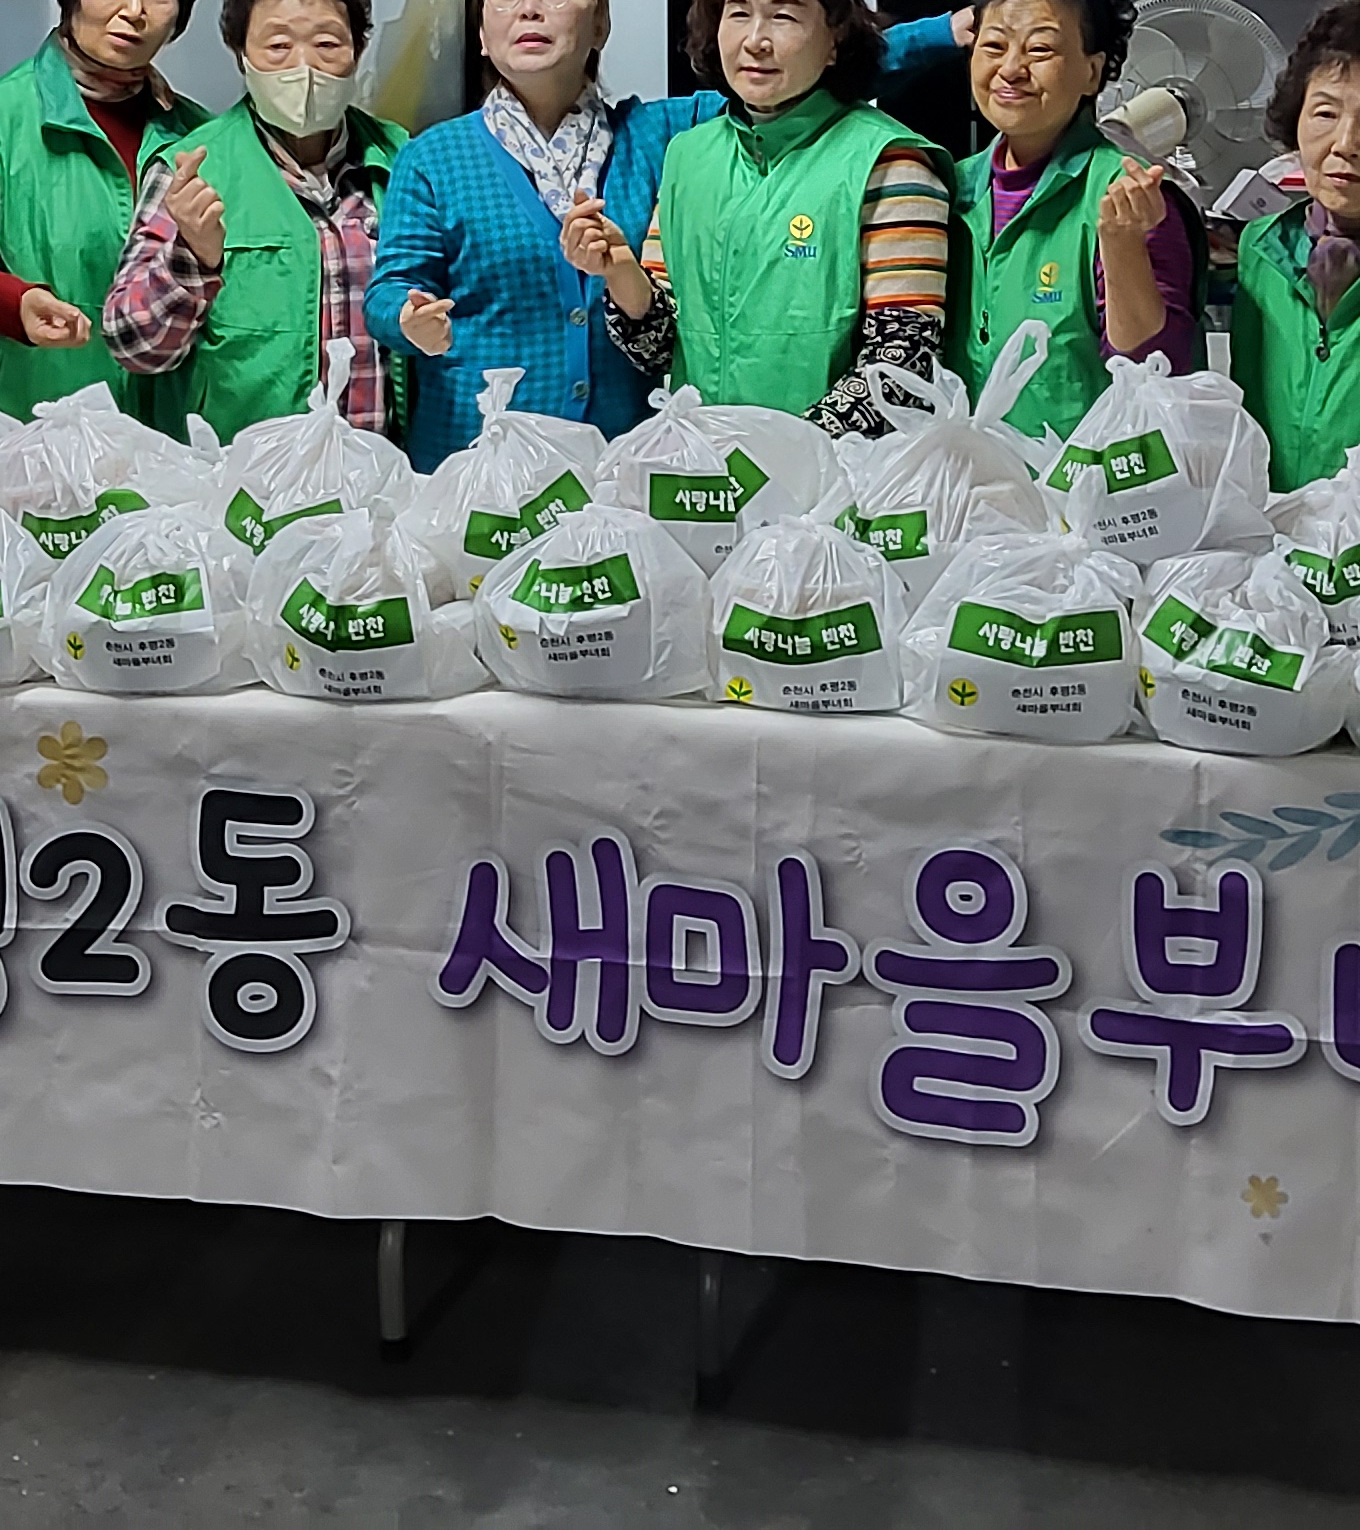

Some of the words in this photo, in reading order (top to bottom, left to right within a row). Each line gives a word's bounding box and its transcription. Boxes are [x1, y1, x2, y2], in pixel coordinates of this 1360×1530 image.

[784, 244, 817, 258] SMU
[1032, 290, 1062, 304] SMU
[1110, 452, 1147, 480] 반찬
[140, 582, 177, 611] 반찬
[347, 614, 386, 642] 반찬
[743, 626, 812, 656] 사랑나눔
[820, 622, 859, 651] 반찬
[977, 621, 1048, 658] 사랑나눔
[1058, 627, 1095, 653] 반찬
[1232, 646, 1272, 677] 반찬
